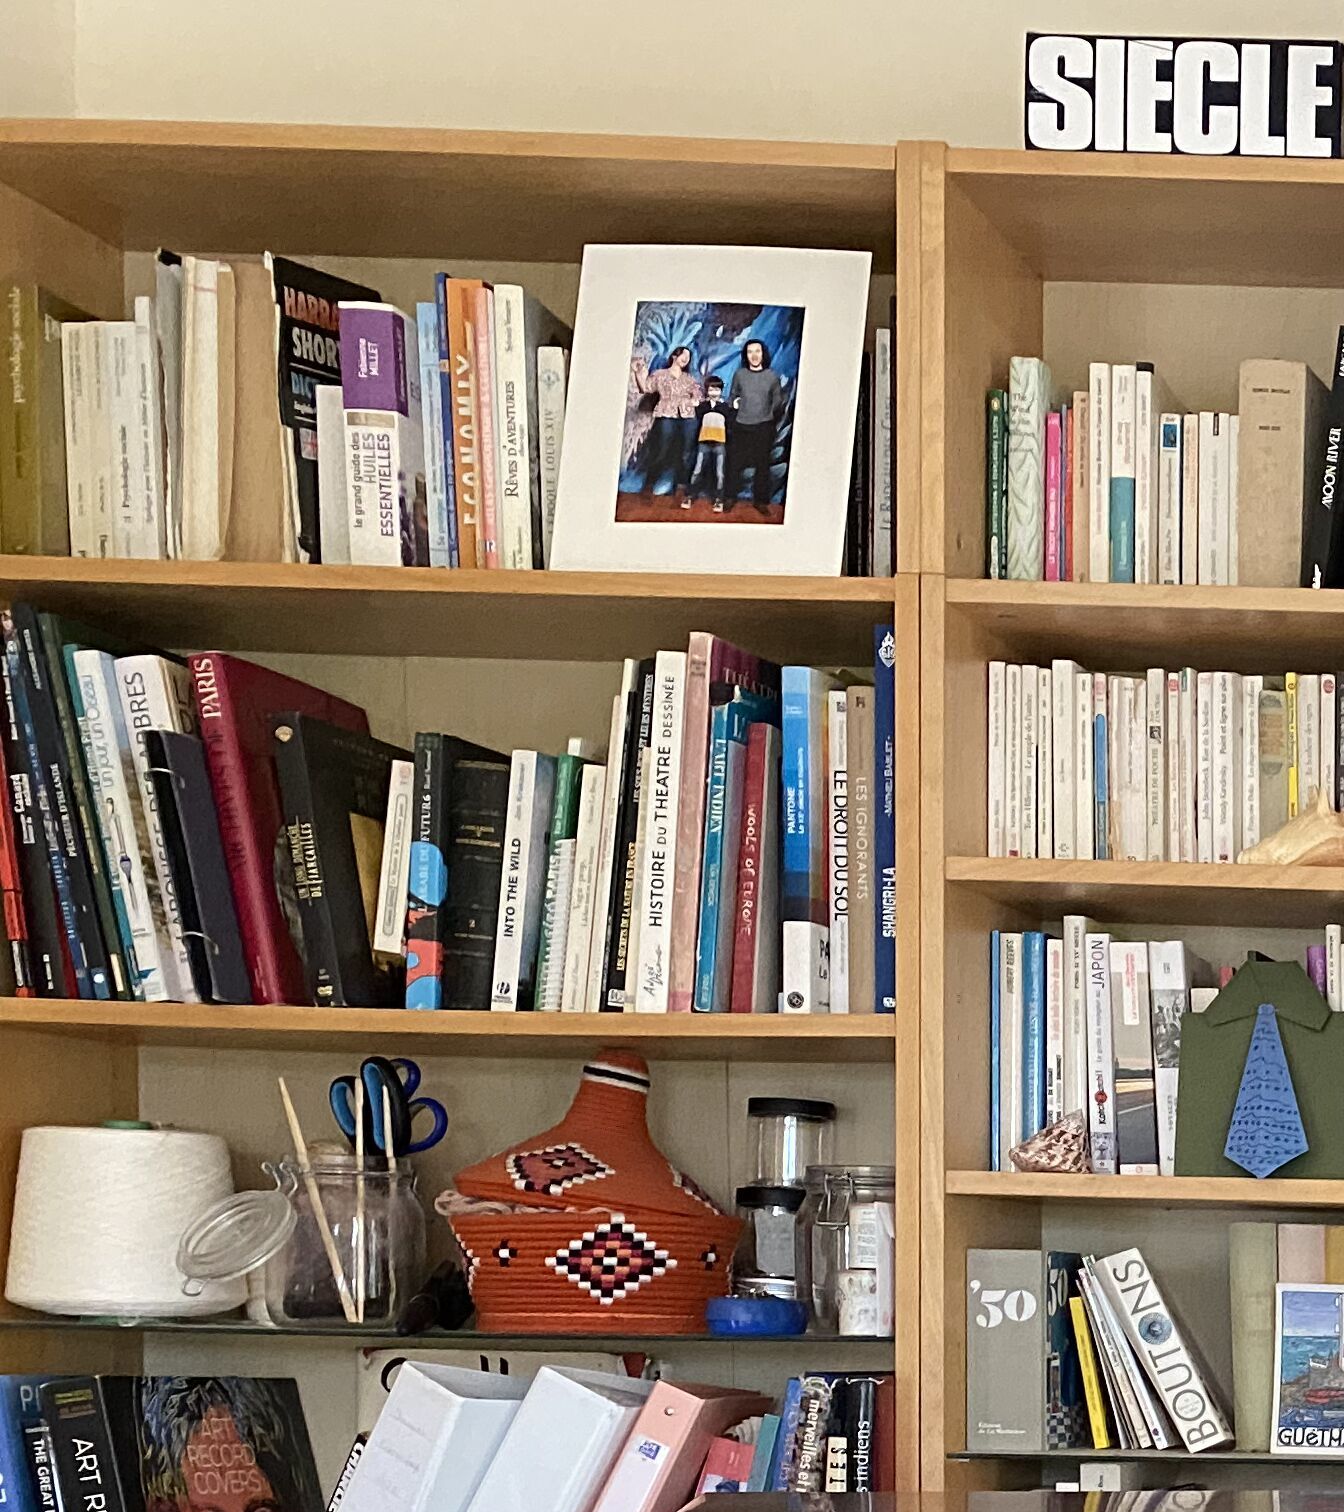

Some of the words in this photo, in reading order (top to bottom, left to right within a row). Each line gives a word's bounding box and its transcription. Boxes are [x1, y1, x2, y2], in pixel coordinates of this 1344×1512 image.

[1026, 36, 1332, 157] SIECLE
[363, 433, 377, 484] HUILES
[1325, 426, 1342, 463] RIVER
[377, 434, 394, 537] ESSENTIELLES
[1320, 465, 1338, 509] MOON
[193, 657, 222, 719] PARIS
[660, 676, 676, 738] DESSINÉE
[653, 746, 672, 822] THEATRE
[833, 770, 848, 792] LE
[855, 776, 868, 801] LES
[786, 787, 796, 834] PANTONE
[833, 795, 848, 850] DROIT
[508, 838, 522, 871] WILD
[655, 826, 667, 845] DU
[855, 808, 868, 899] IGNORANTS
[505, 876, 519, 902] THE
[648, 851, 666, 927] HISTOIRE
[834, 854, 848, 881] DU
[503, 906, 516, 938] INTO
[834, 884, 848, 921] SOL
[882, 866, 896, 937] SHANGRI-LA
[1091, 939, 1105, 989] JAPON
[32, 1439, 45, 1464] THE
[71, 1438, 101, 1485] ART
[37, 1466, 54, 1507] GREAT
